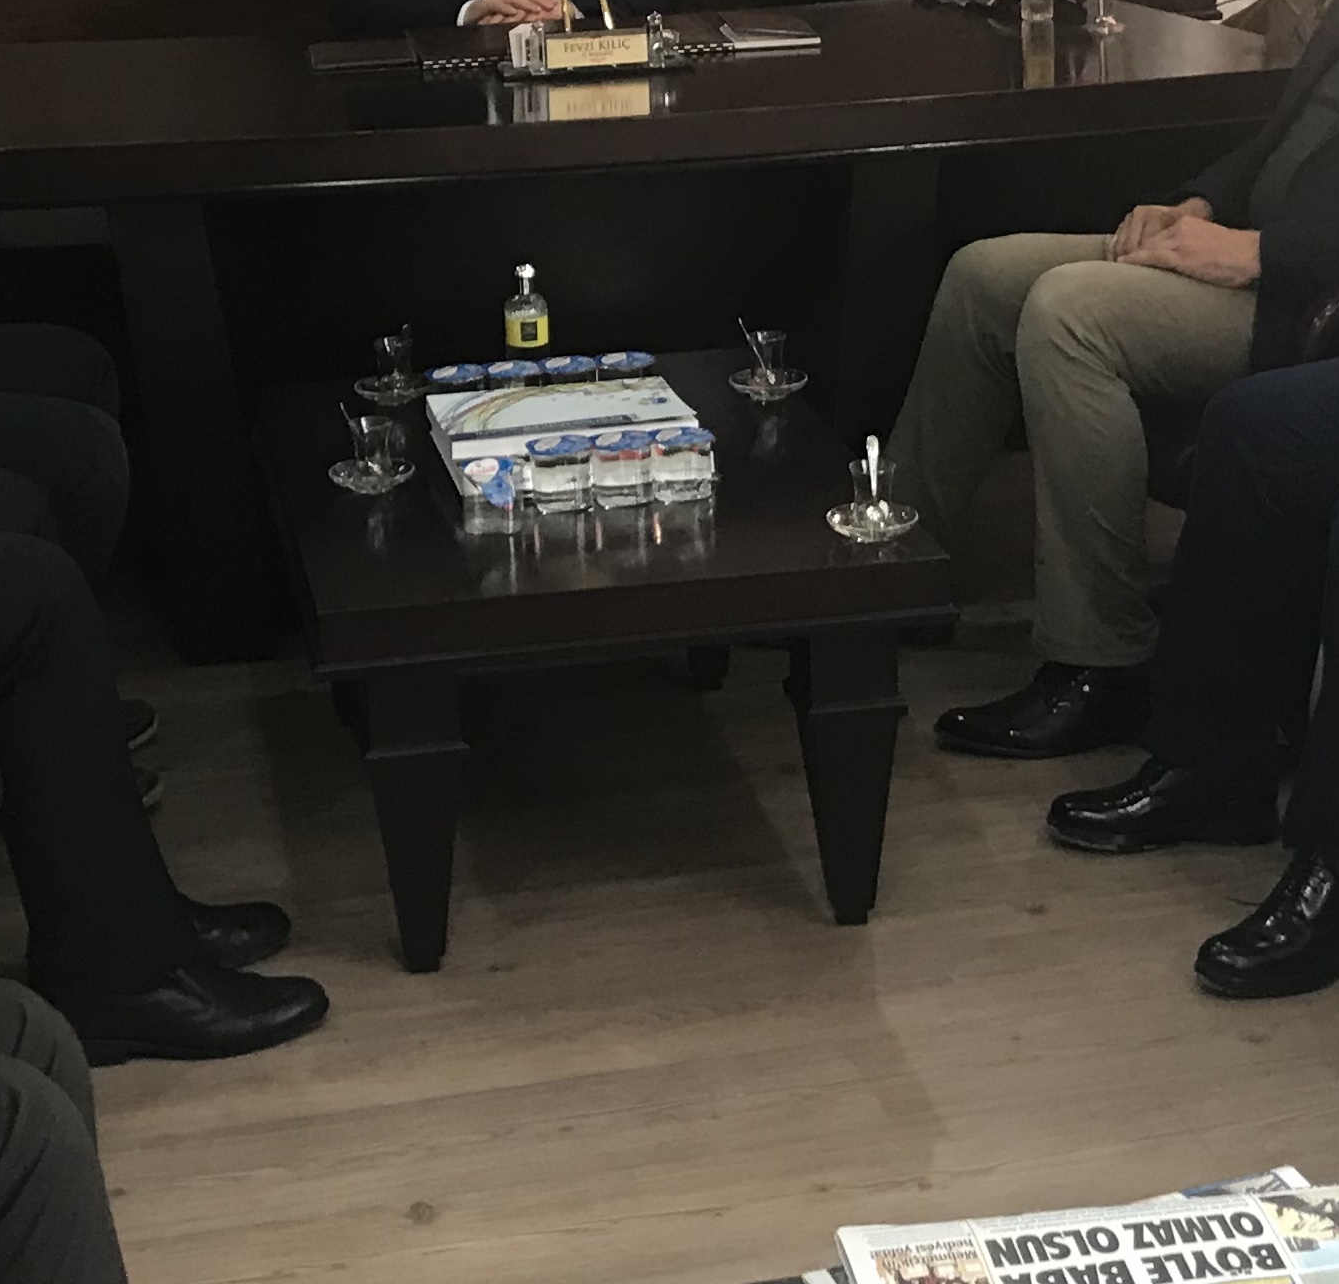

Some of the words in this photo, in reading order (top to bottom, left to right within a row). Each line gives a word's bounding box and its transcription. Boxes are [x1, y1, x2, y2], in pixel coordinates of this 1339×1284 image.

[984, 1226, 1120, 1268] OLSUN
[1122, 1211, 1265, 1250] OLMAZ
[1141, 1243, 1288, 1284] BÖYLE
